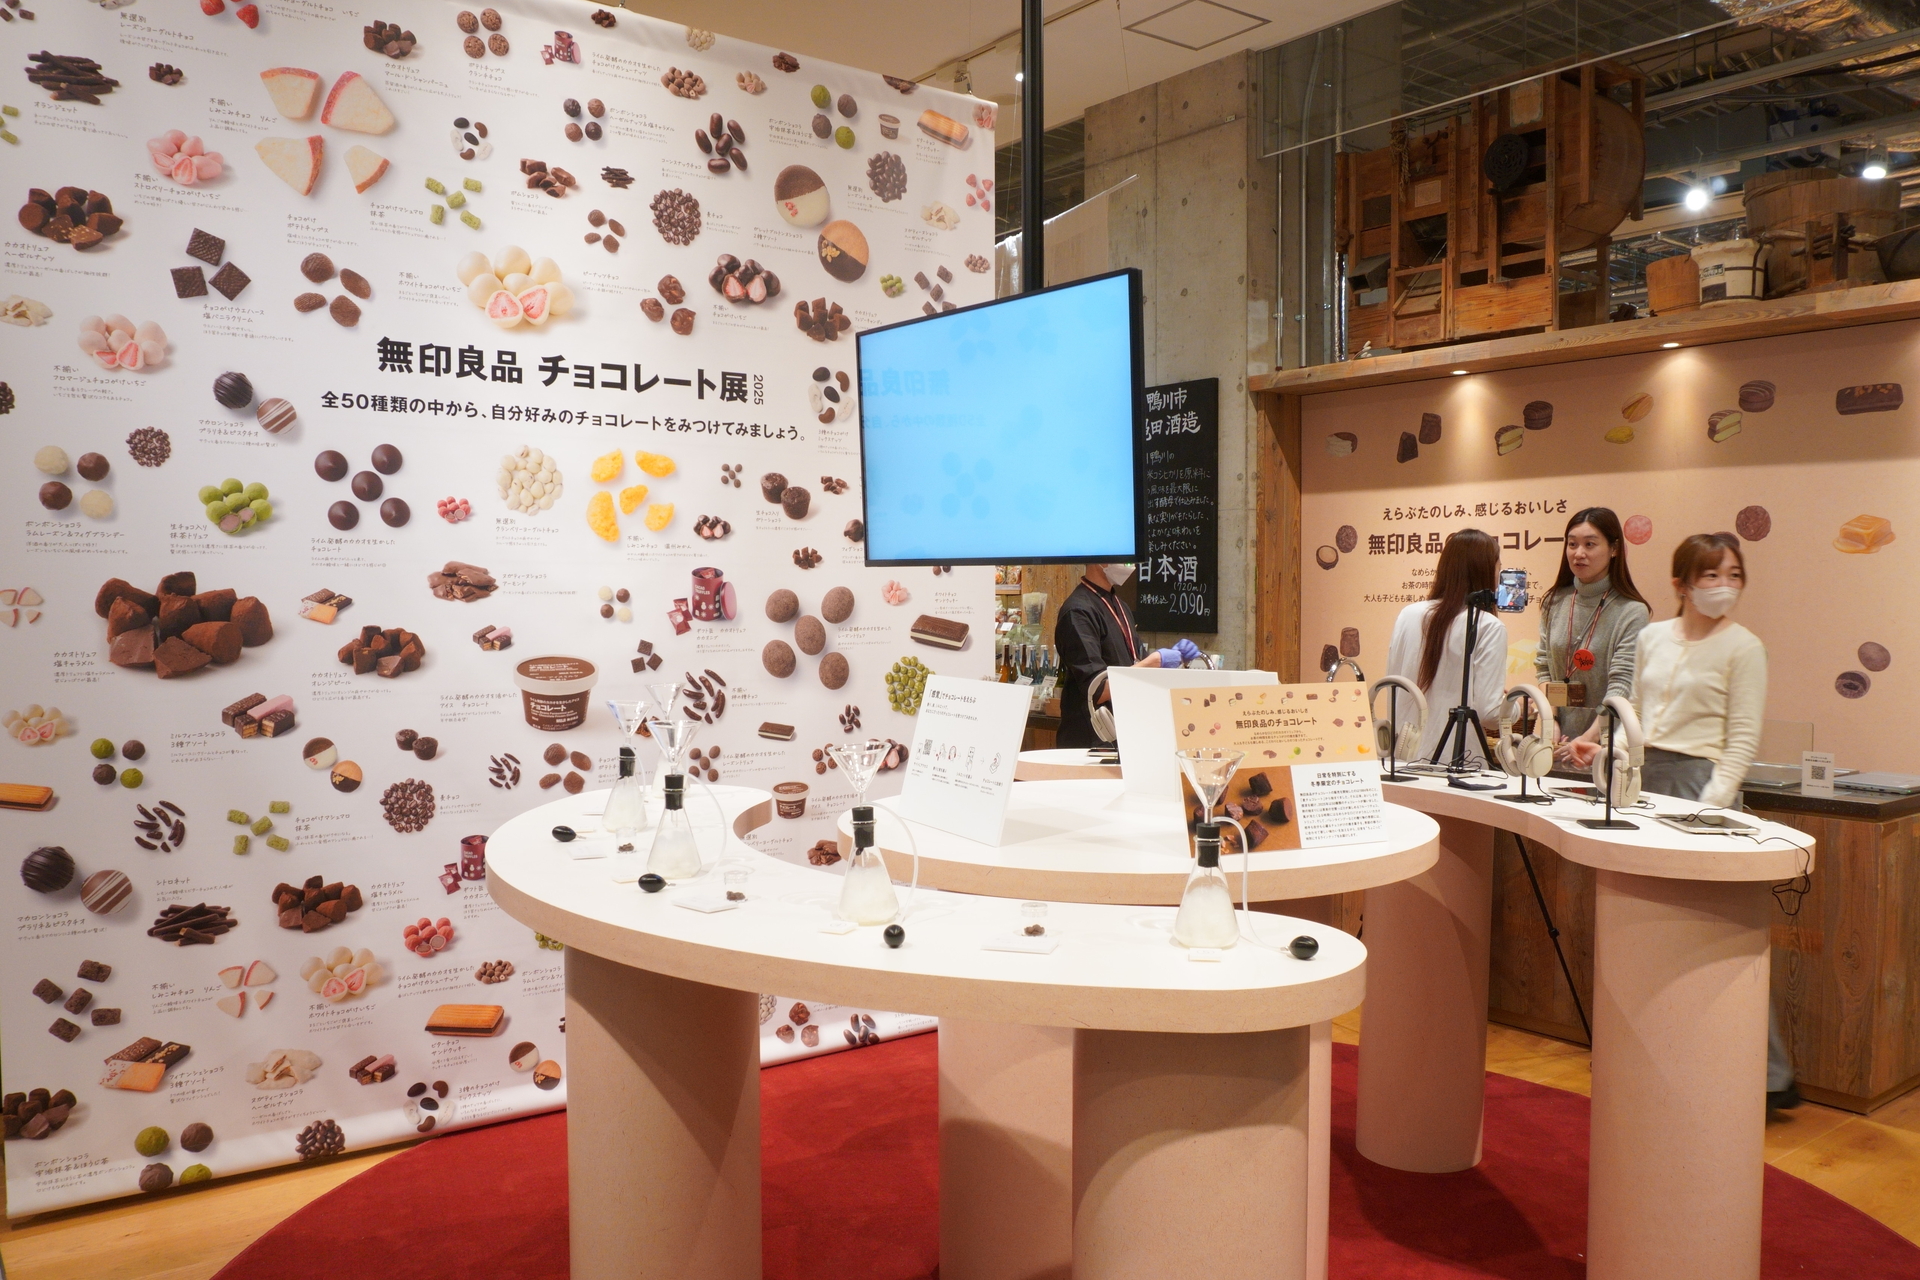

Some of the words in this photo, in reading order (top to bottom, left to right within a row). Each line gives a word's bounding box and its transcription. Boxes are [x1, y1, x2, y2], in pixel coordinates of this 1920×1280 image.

[120, 11, 147, 24] 無選別
[120, 23, 194, 41] レーズンヨーグルトチョコ
[384, 62, 420, 74] カカオトリュフ
[468, 62, 505, 75] ポテトチップス
[468, 70, 503, 82] クランチチョコ
[33, 101, 78, 114] オランジェット
[209, 107, 251, 119] しみこみチョコ
[260, 115, 278, 124] りんご
[134, 182, 221, 200] ストロベリーチョコがけいちご
[370, 202, 424, 216] チョコがけマシュマロ
[370, 210, 386, 219] 抹茶
[286, 213, 317, 224] チョコがけ
[287, 222, 329, 234] ポテトチップス
[4, 241, 50, 253] カカオトリュフ
[4, 251, 55, 262] ヘーゼルナッツ
[582, 270, 619, 281] ピーナッツチョコ
[398, 279, 462, 293] ホワイトチョコがけいちご
[202, 303, 265, 316] チョコがけウエハース
[202, 312, 253, 323] 塩バニラクリーム
[712, 311, 747, 321] チョコがけいちご
[376, 335, 523, 384] 無印良品
[538, 354, 748, 404] チョコレート展
[53, 374, 147, 387] フロマージュチョコがけいちご
[753, 374, 765, 405] 2025
[1146, 387, 1188, 413] 鴨川市
[320, 391, 805, 441] 全50種類の中から、自分好みのチョコレートをみつけてみましょう。
[198, 418, 245, 428] マカロンショコラ
[1382, 499, 1568, 521] えらぶたのしみ、感じるおいしさ
[25, 521, 82, 529] ボンボンショコラ
[170, 523, 208, 531] 生チョコ入り
[495, 525, 559, 534] クランベリーヨーグルトチョコ
[170, 531, 209, 540] 抹茶トリュフ
[311, 545, 342, 553] チョコレート
[1138, 553, 1199, 583] 日本酒
[1140, 593, 1169, 605] 消費税込
[1168, 592, 1210, 617] 2,090円
[53, 659, 95, 667] 塩キャラメル
[311, 671, 348, 679] カカオトリュフ
[311, 679, 351, 687] オレンジピール
[530, 701, 567, 712] チョコレート
[1242, 707, 1309, 716] えらぶたのしみ、感じるおいしさ
[1235, 717, 1317, 730] 無印良品のチョコレート
[170, 731, 226, 739] ミルフィーユショコラ
[171, 740, 208, 748] 3種アソート
[1316, 770, 1357, 779] 日常を特別にする
[1311, 778, 1364, 787] 冬季限定のチョコレート
[440, 793, 460, 801] 麦チョコ
[295, 813, 351, 824] チョコがけマシュマロ
[295, 824, 311, 832] 抹茶
[155, 876, 191, 886] シトロネット
[370, 881, 405, 890] カカオトリュフ
[370, 889, 403, 898] 塩キャラメル
[17, 911, 69, 923] マカロンショコラ
[521, 965, 561, 976] ボンボンショコラ
[397, 975, 460, 989] チョコがけカシューナッツ
[151, 988, 194, 1000] しみこみチョコ
[203, 984, 222, 993] りんご
[309, 1004, 377, 1019] ホワイトチョコがけいちご
[431, 1039, 460, 1049] ビターチョコ
[431, 1045, 467, 1056] サンドクッキー
[169, 1065, 225, 1080] フィナンシェショコラ
[169, 1077, 207, 1089] 3種アソート
[458, 1080, 501, 1094] 3種のチョコがけ
[459, 1090, 492, 1101] ミックスナッツ
[251, 1099, 294, 1111] ヘーゼルナッツ
[34, 1152, 89, 1168] ボンボンショコラ
